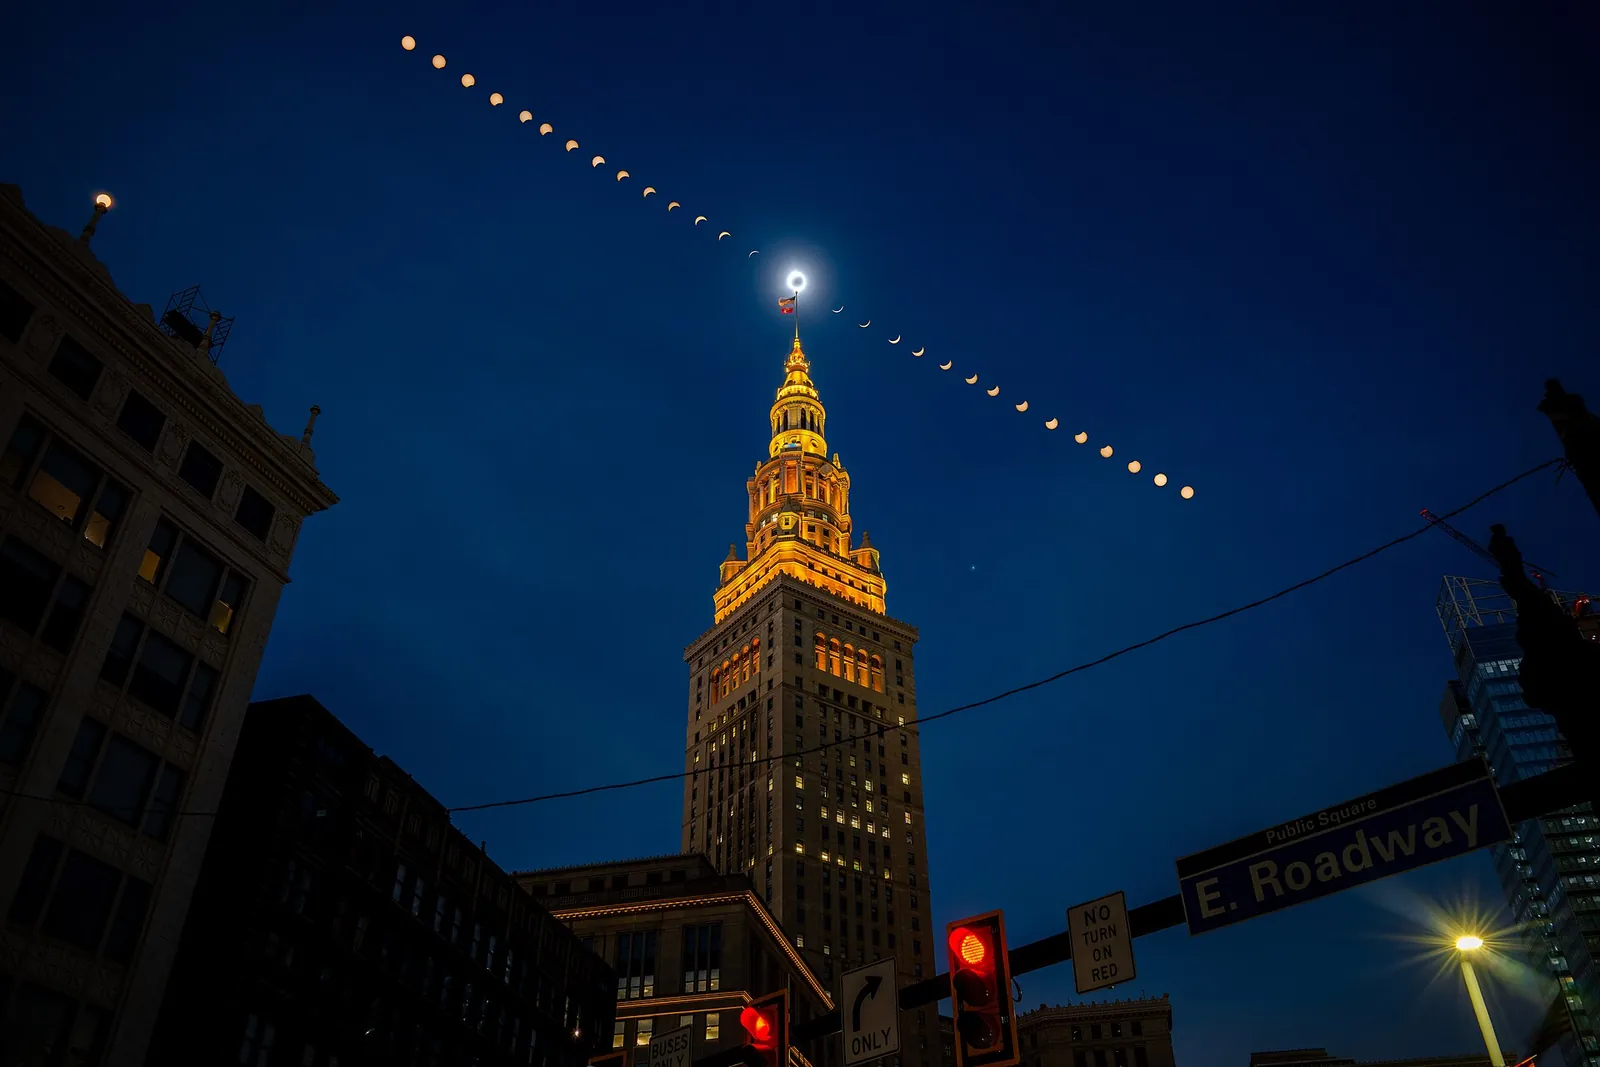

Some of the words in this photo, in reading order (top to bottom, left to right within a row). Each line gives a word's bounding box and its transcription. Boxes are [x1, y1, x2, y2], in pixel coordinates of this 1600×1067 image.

[1266, 820, 1315, 844] Public
[1318, 799, 1377, 826] Square
[1195, 877, 1239, 919] E.
[1249, 804, 1479, 903] Roadway
[1084, 905, 1110, 926] NO
[1081, 924, 1117, 945] TURN
[1092, 944, 1112, 961] ON
[1092, 963, 1117, 982] RED
[652, 1034, 688, 1059] BUSES
[852, 1027, 891, 1055] ONLY
